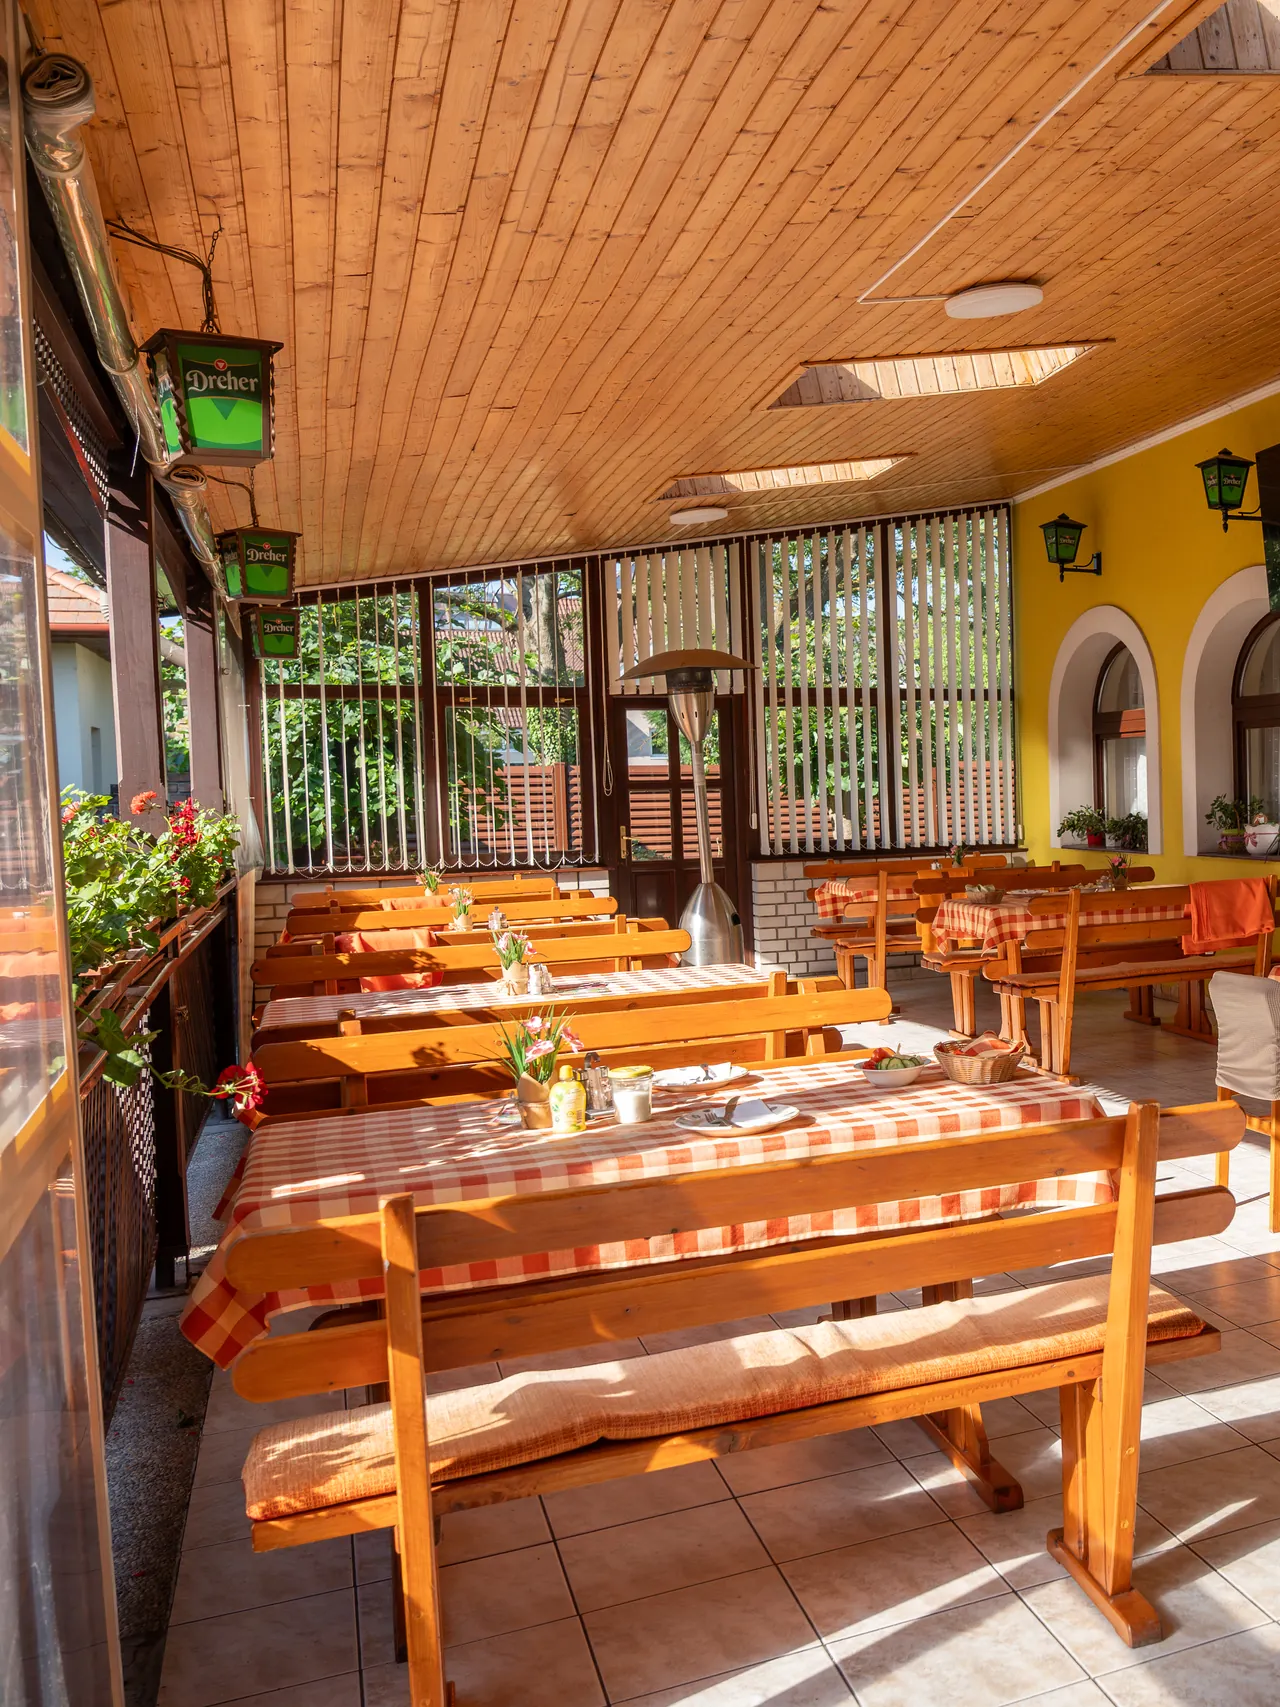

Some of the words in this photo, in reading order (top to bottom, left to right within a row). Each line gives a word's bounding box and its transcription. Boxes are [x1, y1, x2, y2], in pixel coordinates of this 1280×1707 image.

[185, 369, 259, 392] Dreher
[246, 548, 287, 562] Dreher
[263, 623, 294, 633] Dreher
